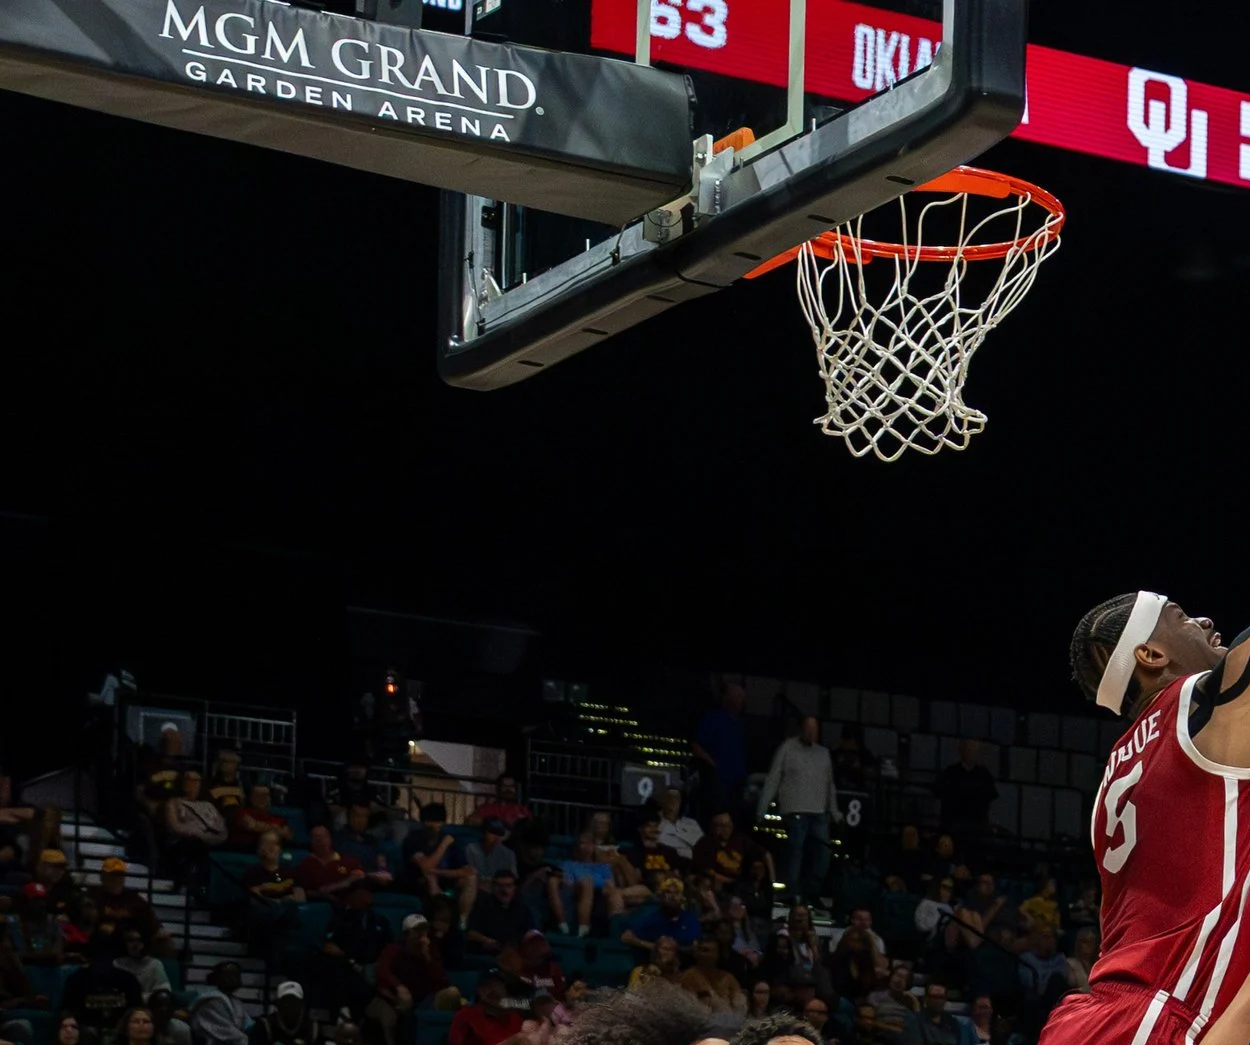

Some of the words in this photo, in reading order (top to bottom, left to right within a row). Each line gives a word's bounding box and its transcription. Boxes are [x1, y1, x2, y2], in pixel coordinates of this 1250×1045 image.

[159, 0, 316, 69] MGM
[331, 38, 537, 110] GRAND
[185, 61, 353, 112] GARDEN
[378, 101, 511, 142] ARENA
[637, 776, 654, 806] 9
[847, 799, 862, 827] 8
